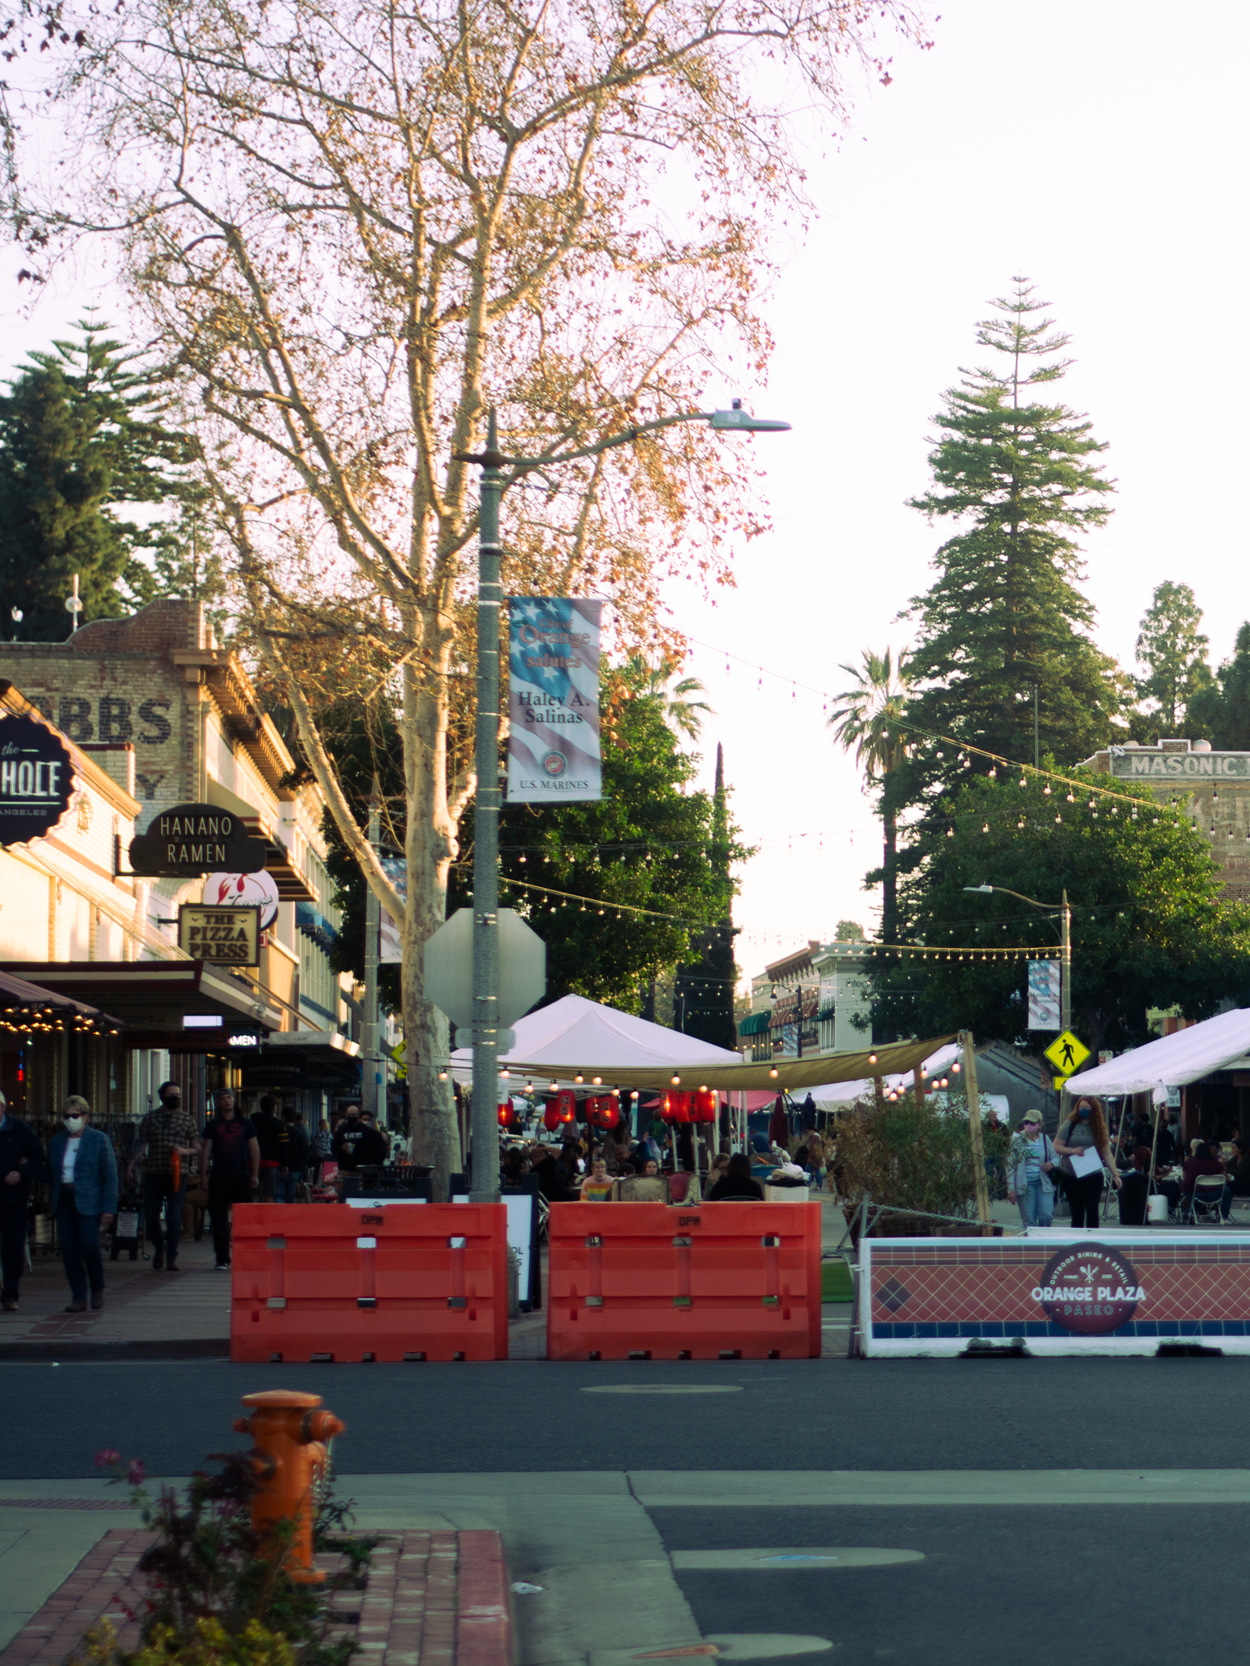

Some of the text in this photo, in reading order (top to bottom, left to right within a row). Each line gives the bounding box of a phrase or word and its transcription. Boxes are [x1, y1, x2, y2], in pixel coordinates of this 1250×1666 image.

[519, 624, 591, 648] Orange
[527, 653, 582, 668] salutes
[517, 691, 590, 709] Haley A.
[525, 708, 583, 724] Salinas
[1, 741, 20, 756] the
[1131, 756, 1237, 775] MASONIC
[520, 779, 589, 790] U.S. MARINES
[160, 816, 232, 836] HANANO
[168, 843, 226, 864] RAMEN
[204, 914, 235, 925] THE
[189, 926, 249, 942] PIZZA
[188, 943, 249, 959] PRESS
[247, 1064, 301, 1074] PROVISIONS
[361, 1214, 385, 1226] DPW
[679, 1215, 701, 1227] DPW
[1049, 1255, 1075, 1285] OUTDOOR
[1077, 1251, 1103, 1259] DINING
[1111, 1261, 1128, 1285] RETAIL
[1031, 1286, 1146, 1301] ORANGE PLAZA
[1063, 1304, 1114, 1316] PASEO
